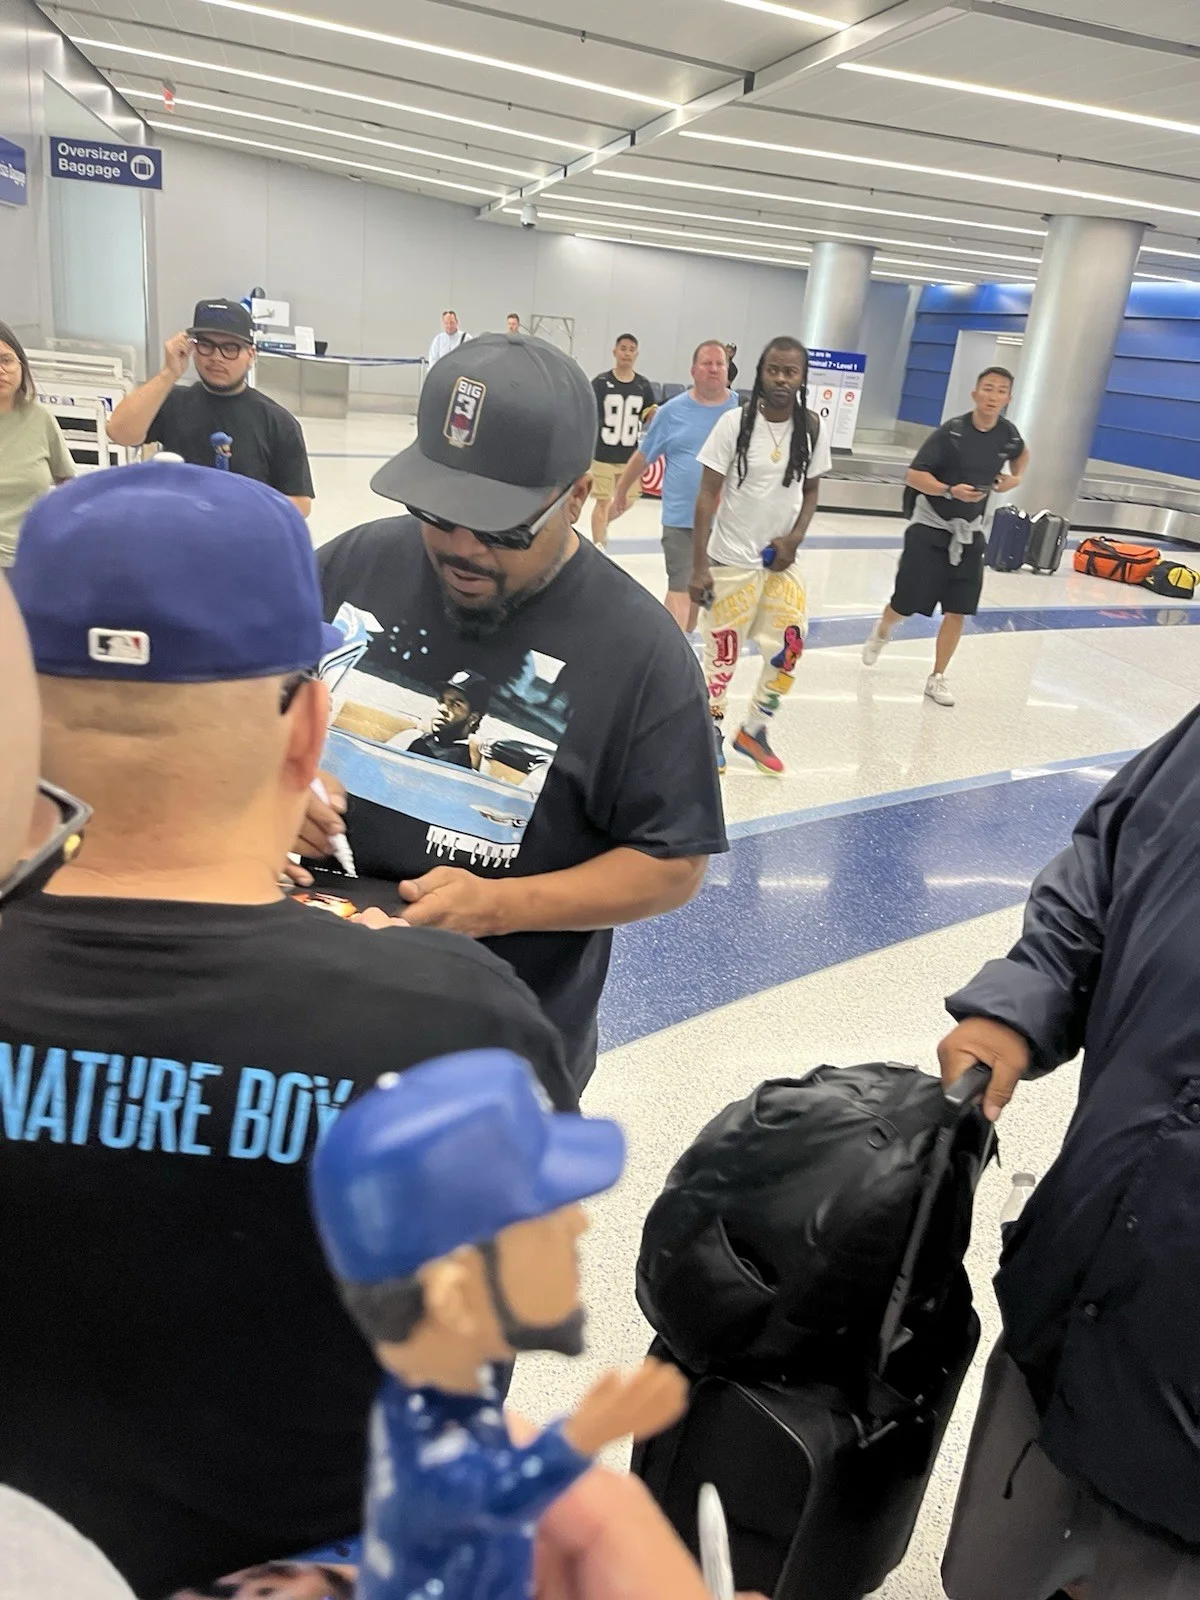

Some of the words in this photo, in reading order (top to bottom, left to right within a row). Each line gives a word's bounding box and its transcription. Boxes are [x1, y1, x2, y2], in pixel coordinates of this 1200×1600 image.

[57, 142, 128, 163] Oversized
[58, 157, 121, 179] Baggage
[836, 361, 854, 371] Level
[854, 363, 858, 371] 1
[458, 380, 482, 398] BIG
[454, 393, 477, 420] 3
[601, 393, 644, 447] 96
[0, 1041, 224, 1157] NATURE
[229, 1066, 354, 1165] BOY
